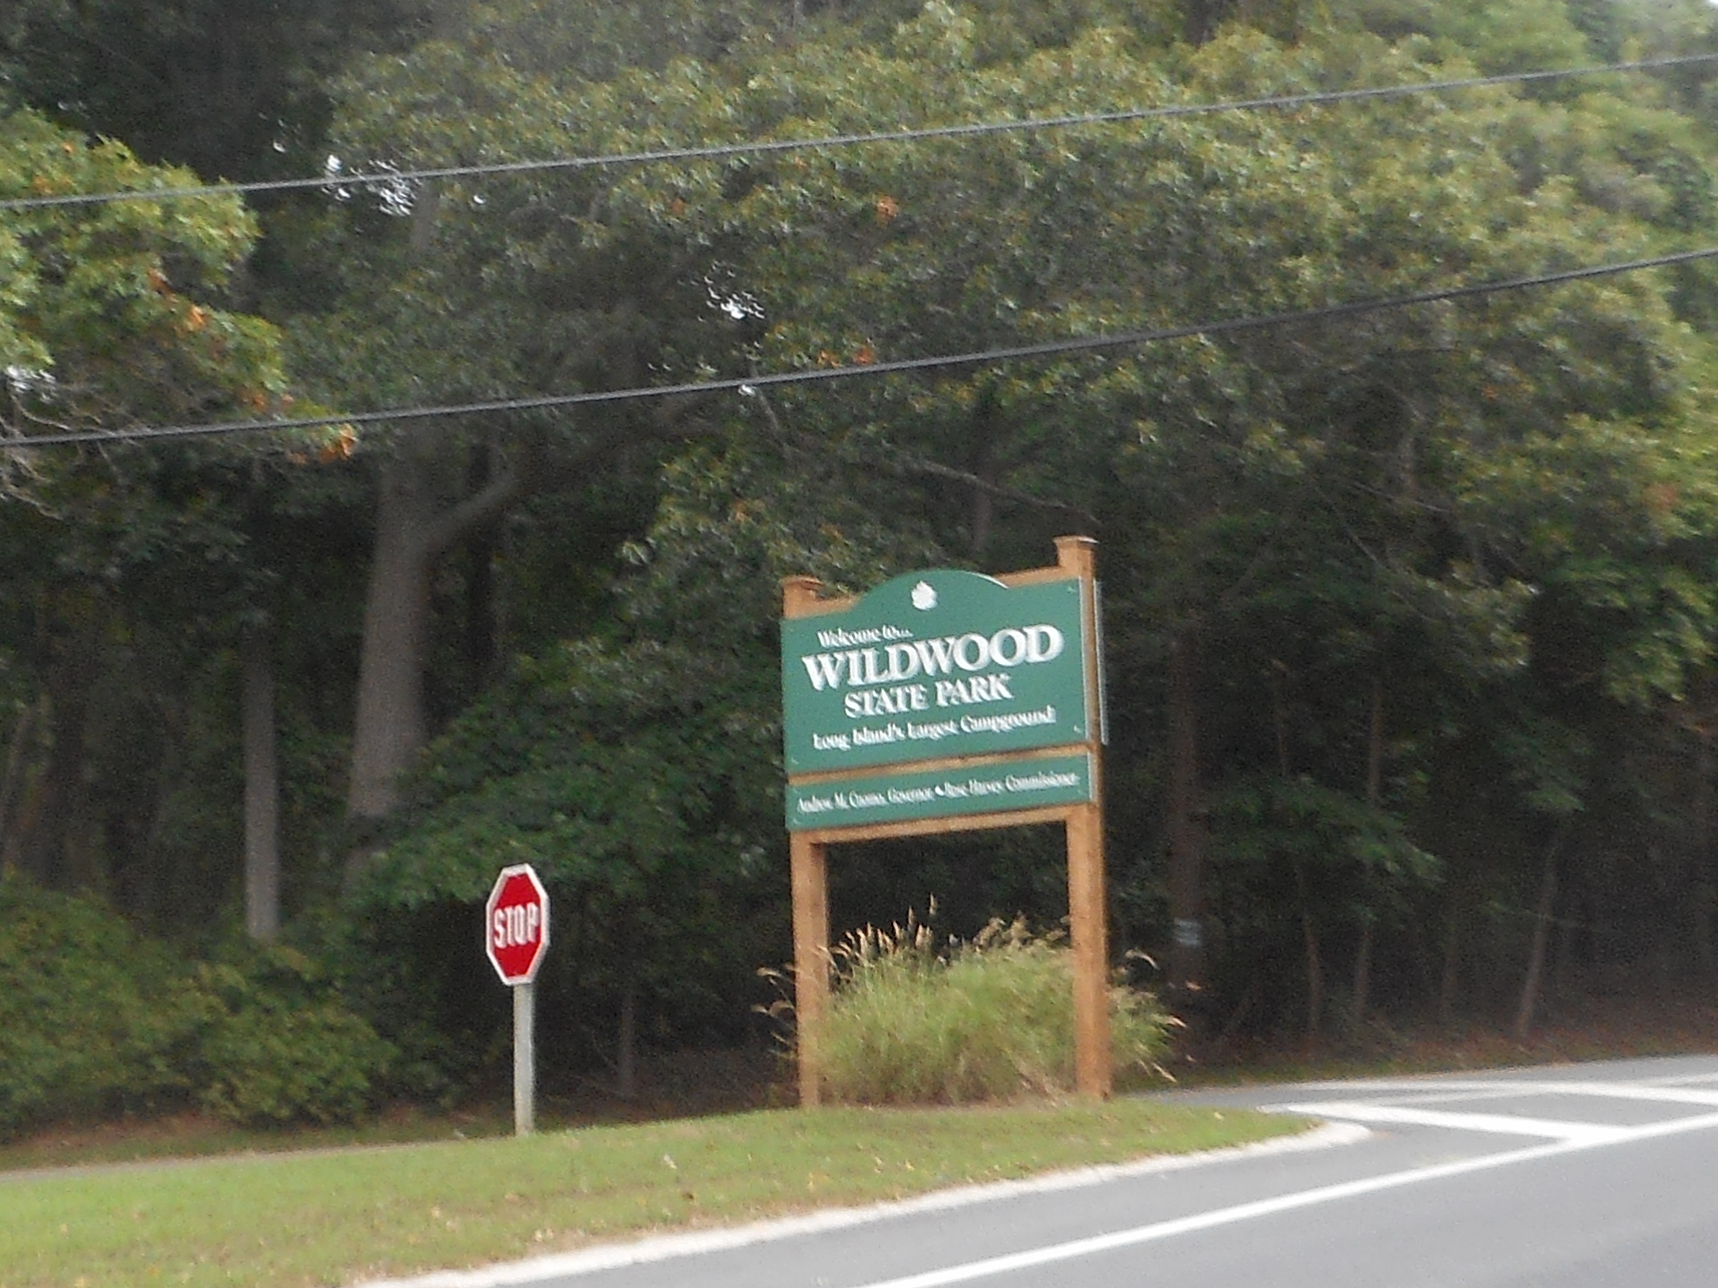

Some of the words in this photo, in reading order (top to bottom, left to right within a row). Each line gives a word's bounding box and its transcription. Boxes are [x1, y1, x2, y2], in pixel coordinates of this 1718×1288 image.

[802, 624, 1064, 691] WILDWOOD
[817, 628, 881, 649] Welcome
[845, 684, 930, 719] STATE
[934, 673, 1014, 707] PARK
[813, 733, 851, 753] Long
[852, 722, 906, 745] Island's
[907, 720, 959, 741] Largest
[494, 901, 540, 949] STOP
